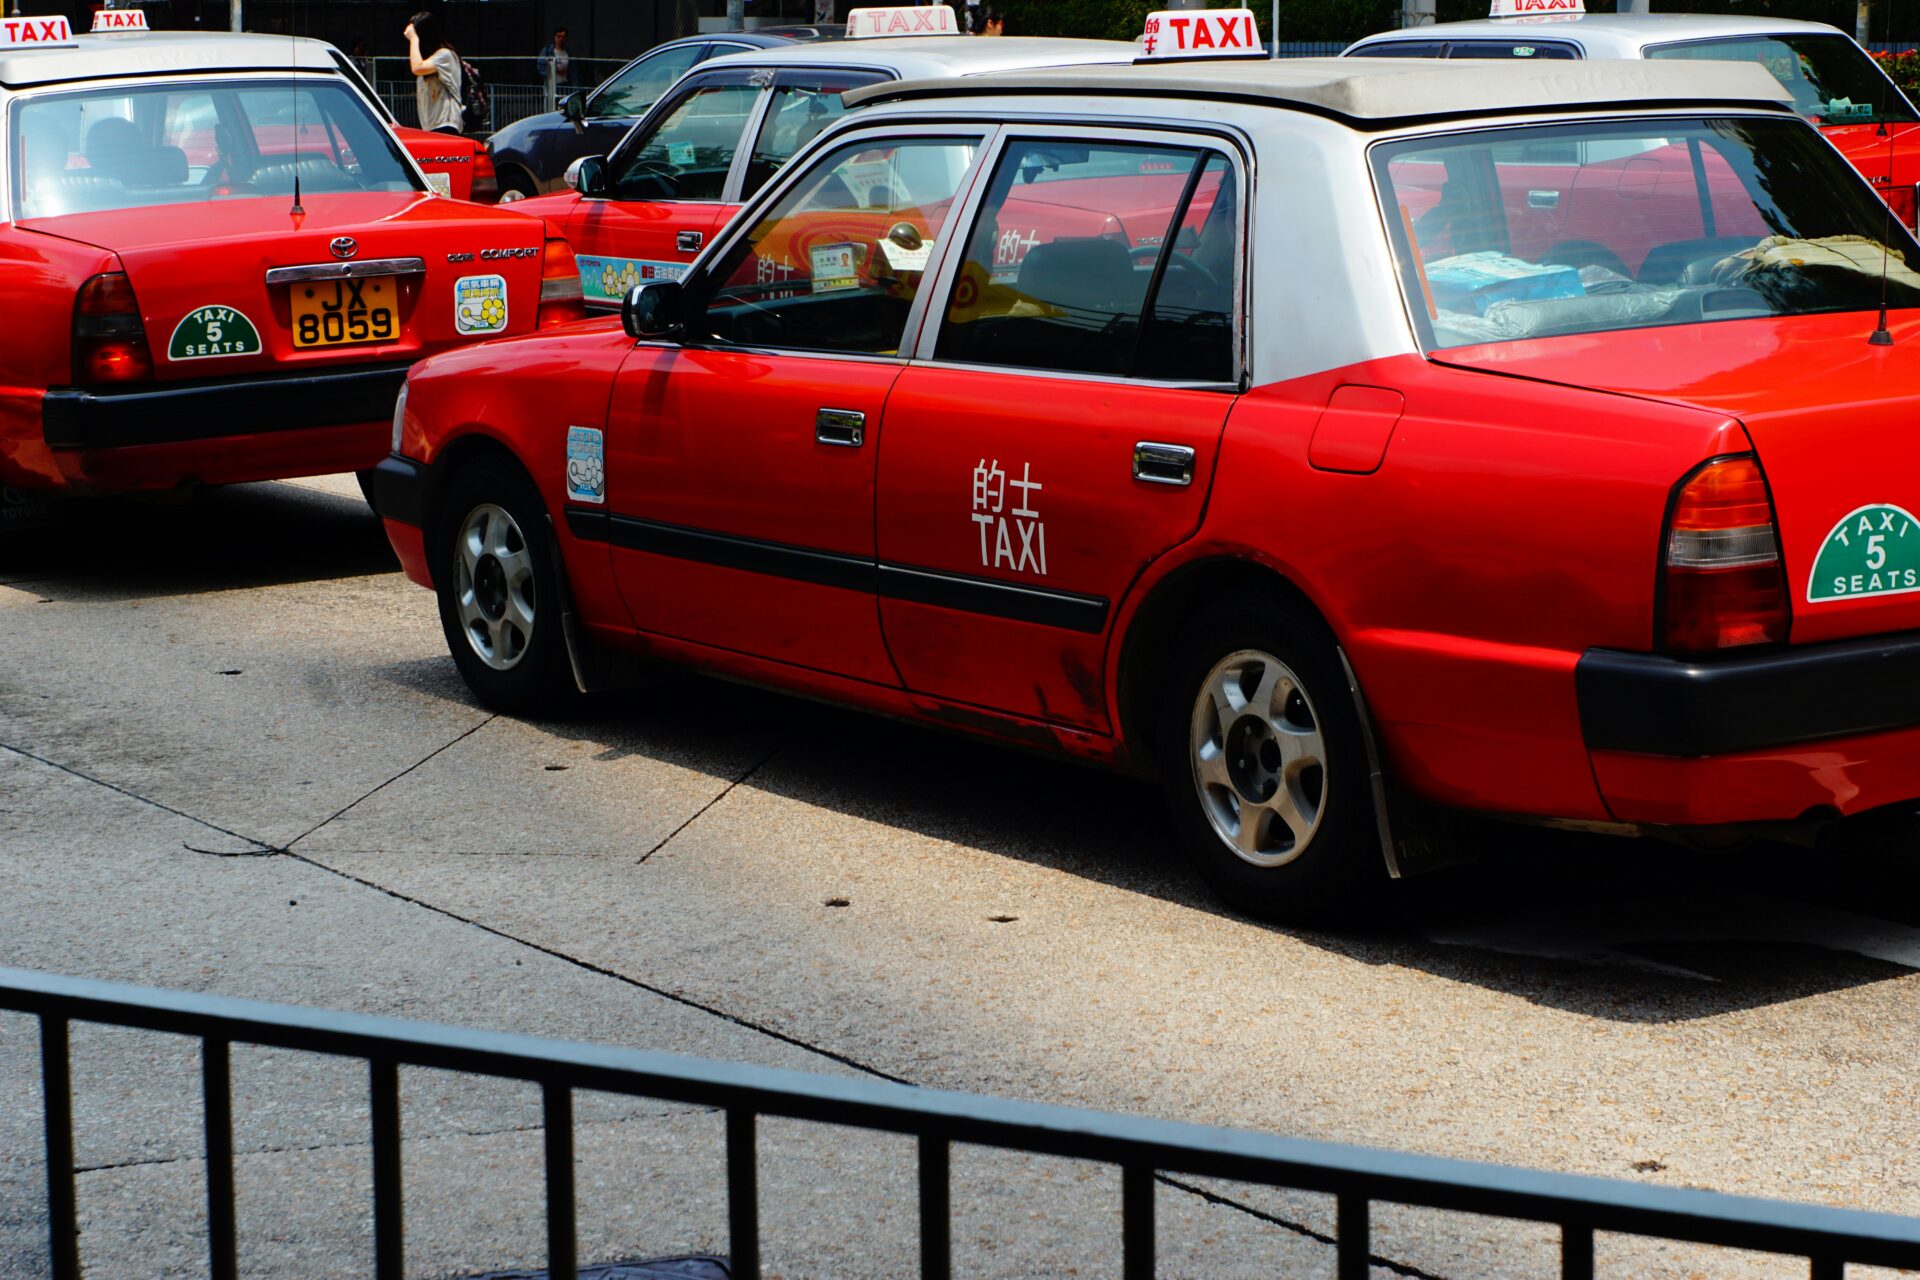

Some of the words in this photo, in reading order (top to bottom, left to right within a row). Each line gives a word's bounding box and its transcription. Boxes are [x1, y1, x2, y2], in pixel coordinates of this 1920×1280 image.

[4, 21, 67, 42] TAXI
[103, 13, 143, 27] TAXI
[866, 9, 947, 32] TAXI
[1144, 18, 1159, 51] 的士
[1169, 17, 1253, 49] TAXI
[480, 247, 539, 259] COMFORT
[322, 277, 367, 312] JX
[193, 308, 235, 324] TAXI
[299, 308, 391, 344] 8059
[206, 321, 223, 342] 5
[185, 341, 245, 355] SEATS
[973, 458, 1042, 518] 的士
[971, 512, 1047, 575] TAXI
[1834, 511, 1909, 547] TAXI
[1866, 534, 1886, 570] 5
[1833, 568, 1917, 594] SEATS
